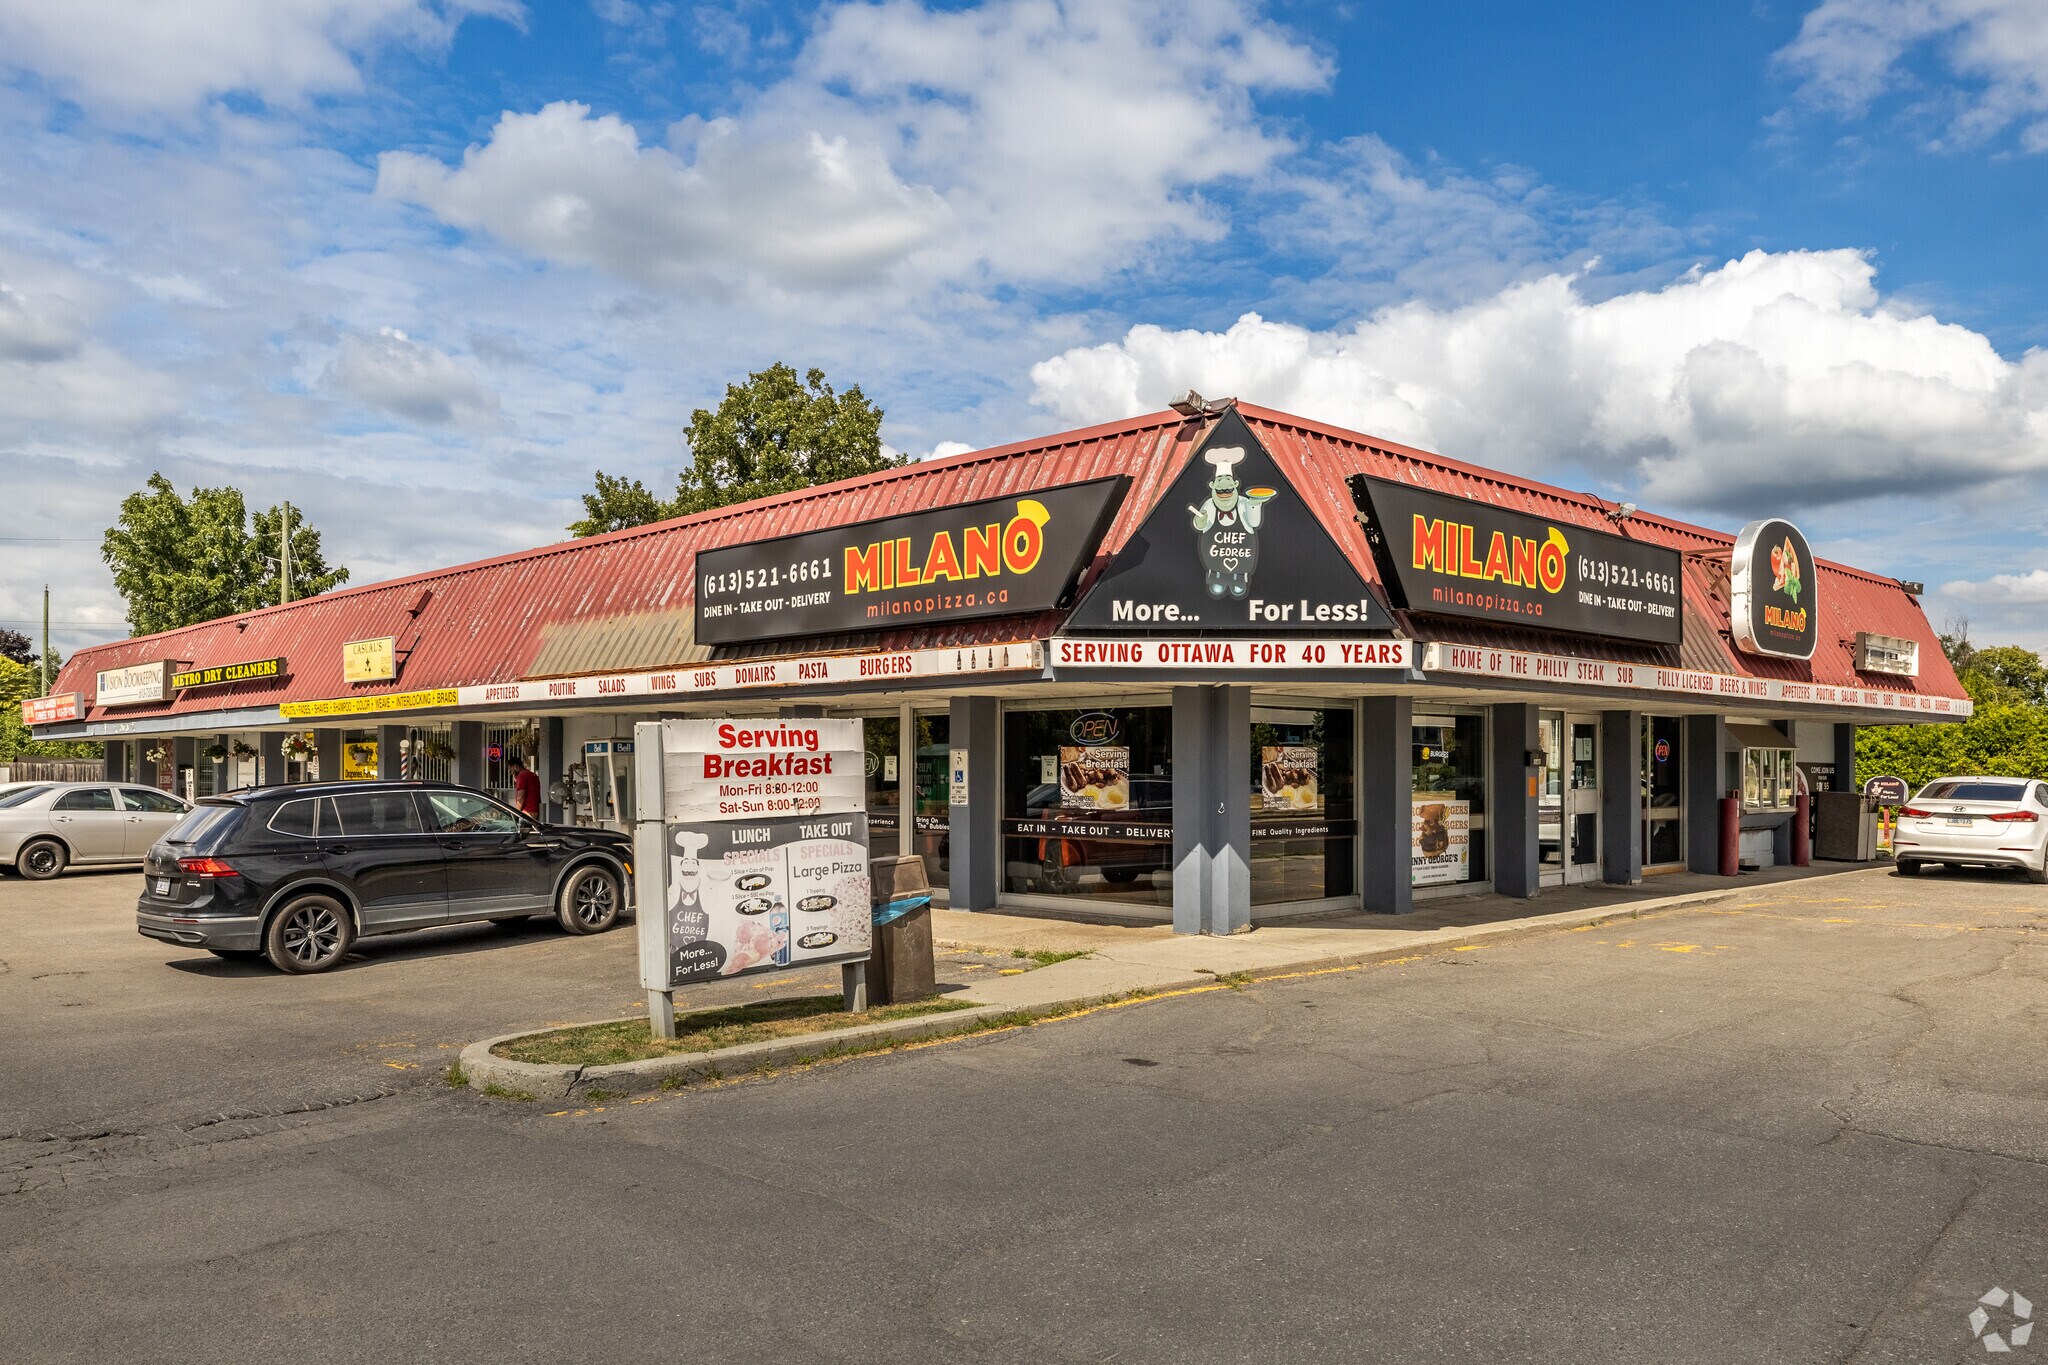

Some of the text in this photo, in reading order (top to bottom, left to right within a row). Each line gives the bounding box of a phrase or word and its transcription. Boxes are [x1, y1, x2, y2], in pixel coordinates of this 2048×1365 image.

[1214, 532, 1246, 544] CHEF
[845, 500, 1051, 595] MILANO
[1210, 545, 1251, 558] GEORGE
[1412, 514, 1570, 594] MILANO
[703, 558, 832, 598] (613)521-6661
[1578, 555, 1675, 595] (613)521-6661
[704, 591, 831, 618] DINE IN TAKE OUT DELIVERY
[866, 588, 1009, 618] milanopizza.ca
[1433, 586, 1543, 616] milanopizza.ca
[1579, 591, 1675, 617] DINE IN TAKE OUT DELIVERY
[1112, 600, 1200, 621] More...
[1249, 600, 1368, 621] For Less!
[1765, 605, 1807, 633] MILANO
[353, 641, 383, 655] CASUAL'S
[1061, 643, 1403, 664] SERVING OTTAWA FOR 40 YEARS
[172, 660, 277, 688] METRO DRY CLEANERS
[1452, 648, 1633, 683] HOME OF THE PHILLY STEAK SUB
[485, 655, 912, 701] APPETIZERS POUTINE SALADS WINGS SUBS DONAIRS PASTA BURGERS
[1657, 670, 1767, 696] FULLY LICENSED BEERS & WINES
[314, 703, 328, 713] SHAVES
[333, 702, 351, 712] SHAMPOO
[357, 699, 370, 711] COLOR
[375, 698, 390, 709] WEAVE
[396, 693, 431, 706] INTERLOCKING
[437, 691, 457, 704] BRAIDS
[1781, 685, 1951, 711] APPETIZERS POUTINE SALADS WINGS SUBS DONAIRS PASTA BURGERS
[718, 723, 819, 751] Serving
[1073, 719, 1118, 737] OPEN
[617, 743, 631, 753] Bell
[1095, 749, 1128, 760] Serving
[1290, 749, 1316, 760] Serving
[1430, 750, 1449, 758] BURGERS
[703, 752, 832, 778] Breakfast
[1085, 760, 1129, 769] Breakfast
[1283, 760, 1317, 769] Breakfast
[720, 784, 762, 797] Mon-Fri
[720, 800, 764, 814] Sat-Sun
[916, 817, 929, 825] Bring
[1018, 824, 1034, 832] EAT
[1036, 825, 1046, 833] IN
[1062, 826, 1086, 835] TAKE
[1089, 827, 1110, 836] OUT
[732, 828, 771, 845] LUNCH
[799, 822, 853, 839] TAKE OUT
[1270, 828, 1292, 836] Quality
[1295, 826, 1329, 834] Ingredients
[723, 848, 780, 866] SPECIALS
[800, 843, 853, 859] SPECIALS
[1428, 854, 1459, 865] GEORGE'S
[793, 861, 862, 880] Large Pizza
[676, 910, 704, 923] CHEF
[672, 922, 706, 936] GEORGE
[810, 924, 829, 932] Toppings
[680, 946, 713, 961] More...
[675, 957, 719, 976] For Less!
